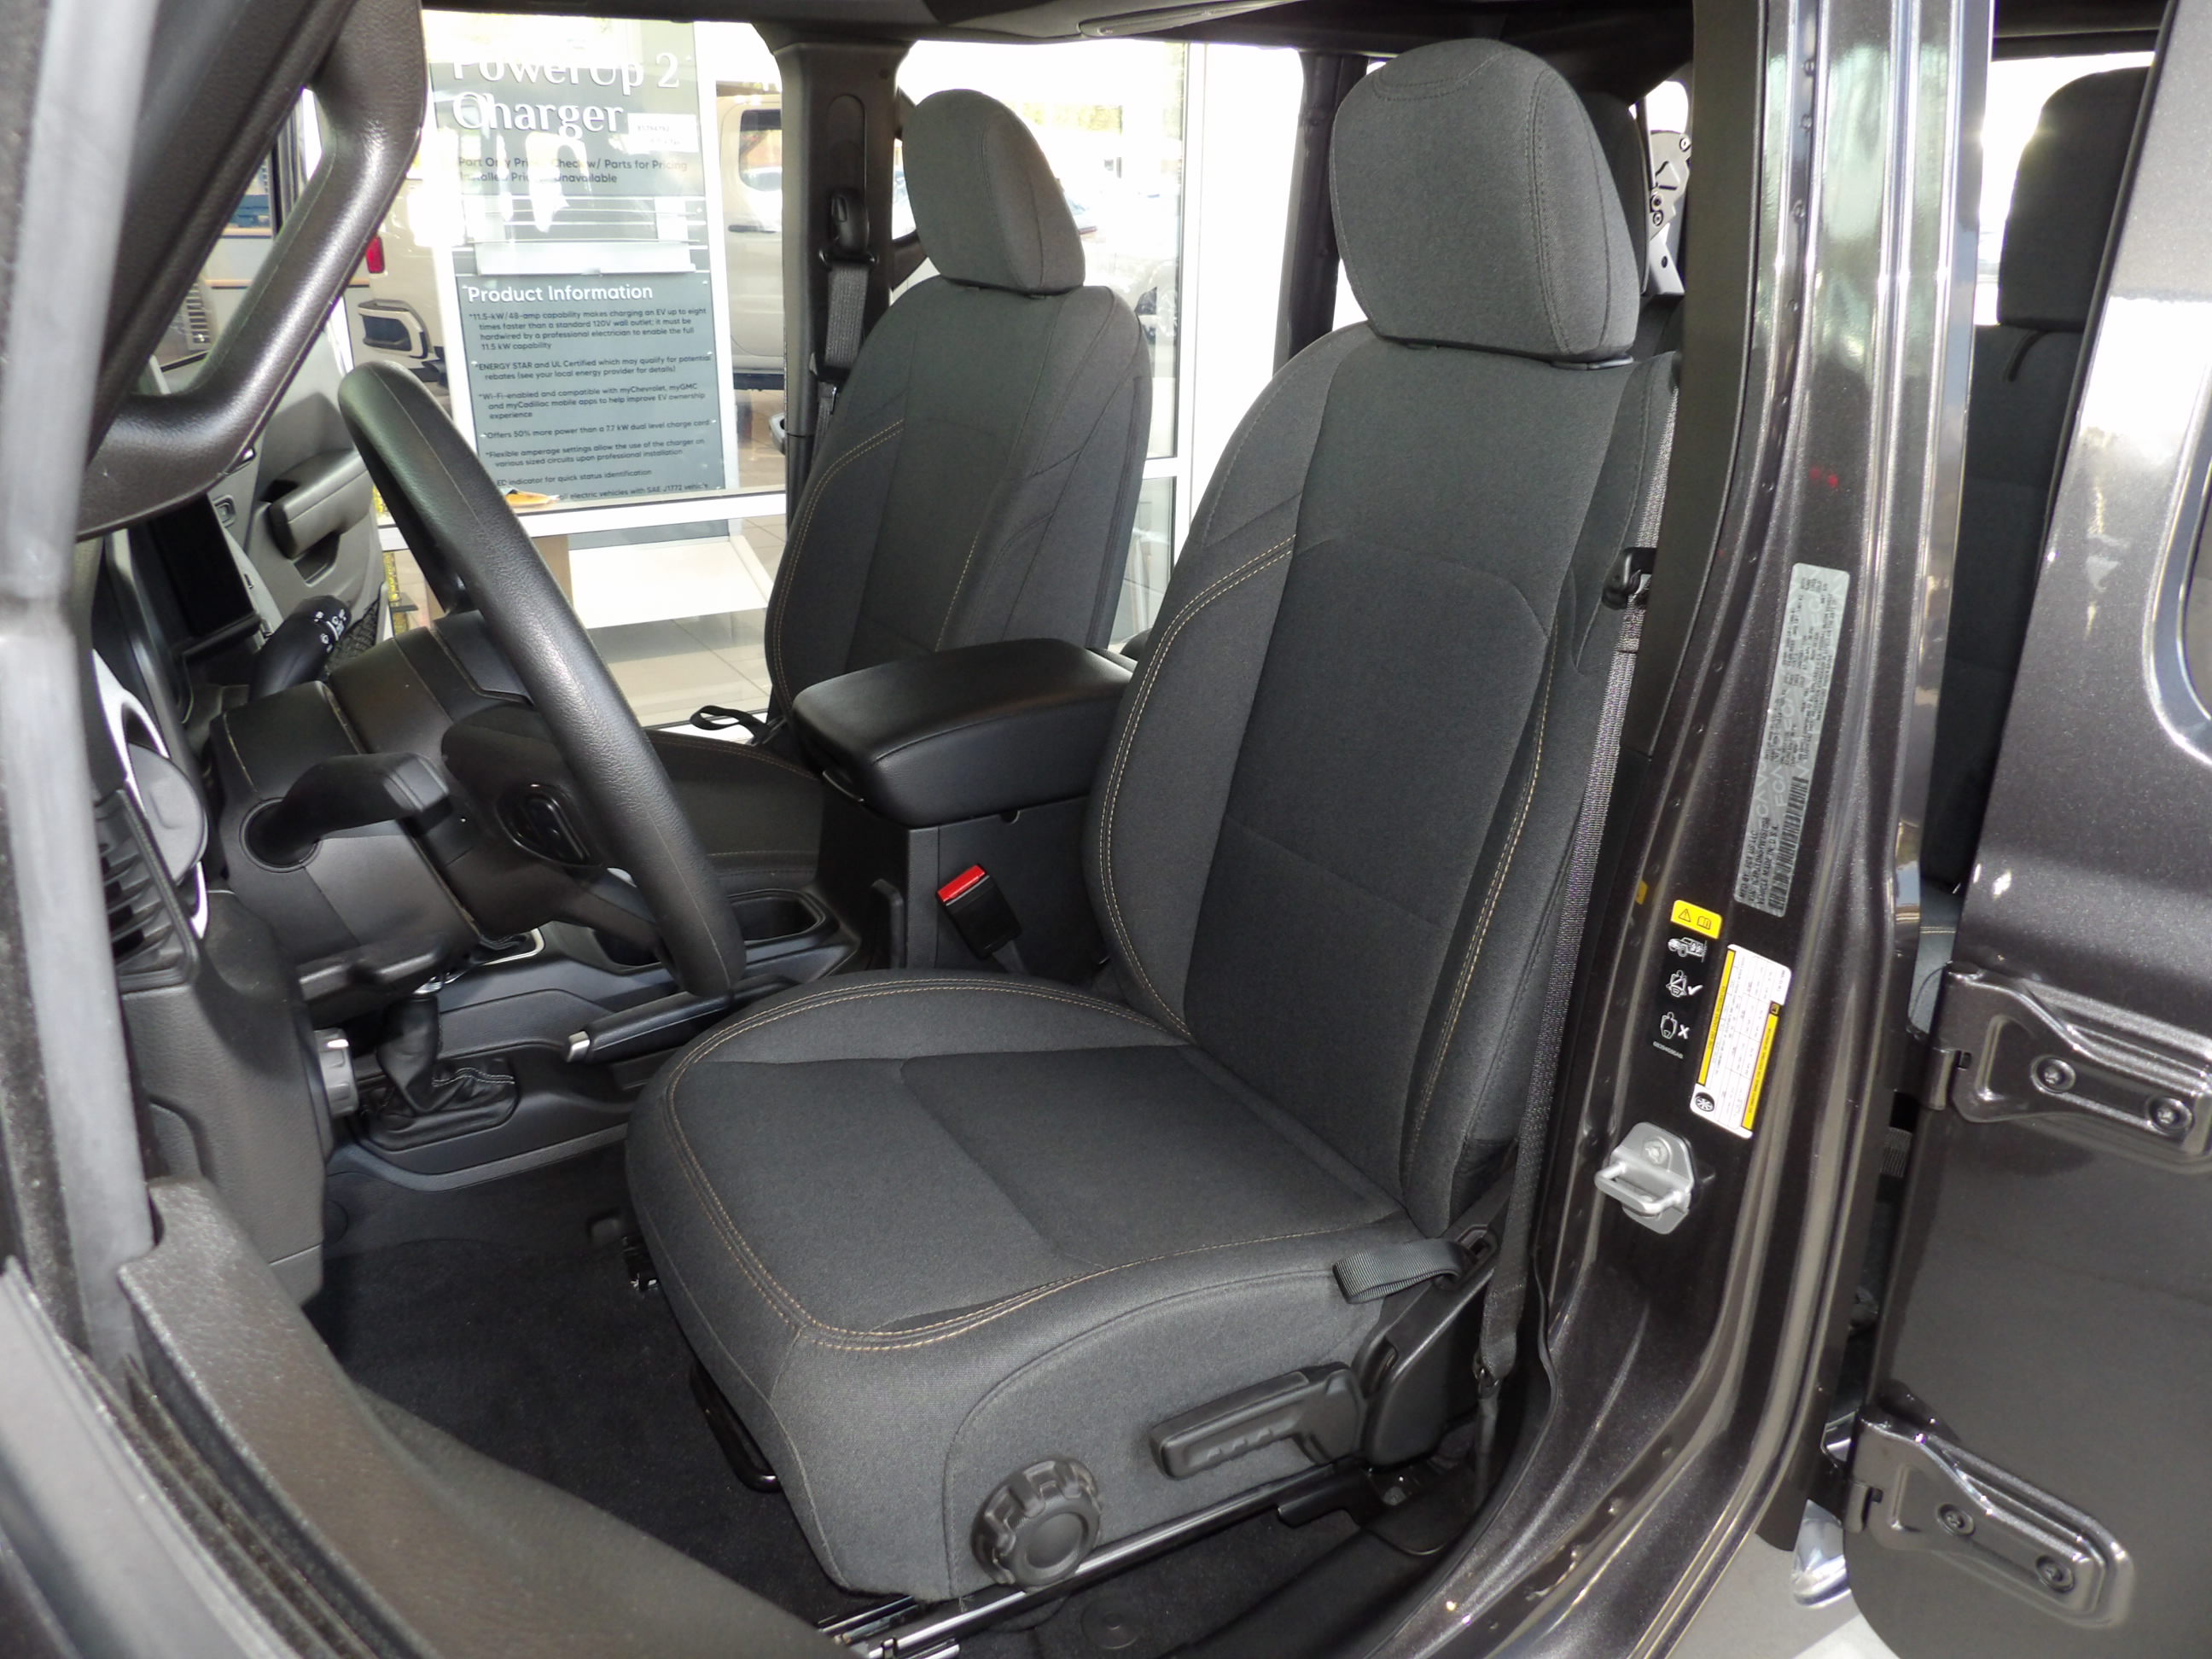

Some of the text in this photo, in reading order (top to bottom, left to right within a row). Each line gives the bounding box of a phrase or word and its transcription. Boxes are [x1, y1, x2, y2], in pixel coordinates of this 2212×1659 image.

[656, 52, 680, 88] 2
[453, 91, 624, 141] Charger
[458, 157, 482, 167] Part
[485, 157, 511, 168] Oy
[551, 159, 585, 168] Chec
[587, 159, 601, 168] w/
[604, 159, 632, 169] Parts
[635, 160, 649, 169] for
[652, 160, 687, 172] Pricing
[467, 284, 653, 302] Product Information
[545, 311, 581, 319] capability
[609, 310, 643, 318] charging
[613, 318, 629, 327] wall
[480, 332, 521, 341] hardwired
[542, 330, 590, 340] professional
[512, 341, 553, 351] capability
[563, 359, 597, 368] Certified
[603, 368, 635, 376] provider
[558, 388, 601, 397] compatible
[669, 383, 697, 392] myGMC
[506, 400, 550, 410] myCadillac
[608, 396, 626, 405] help
[626, 395, 656, 404] improve
[668, 393, 706, 401] ownership
[489, 410, 533, 420] experience
[521, 448, 561, 457] amperage
[597, 451, 643, 461] professional
[643, 449, 684, 457] installation
[509, 477, 544, 486] indicator
[557, 474, 578, 483] quick
[604, 469, 652, 478] identification
[570, 491, 598, 499] electric
[599, 488, 629, 497] vehicles
